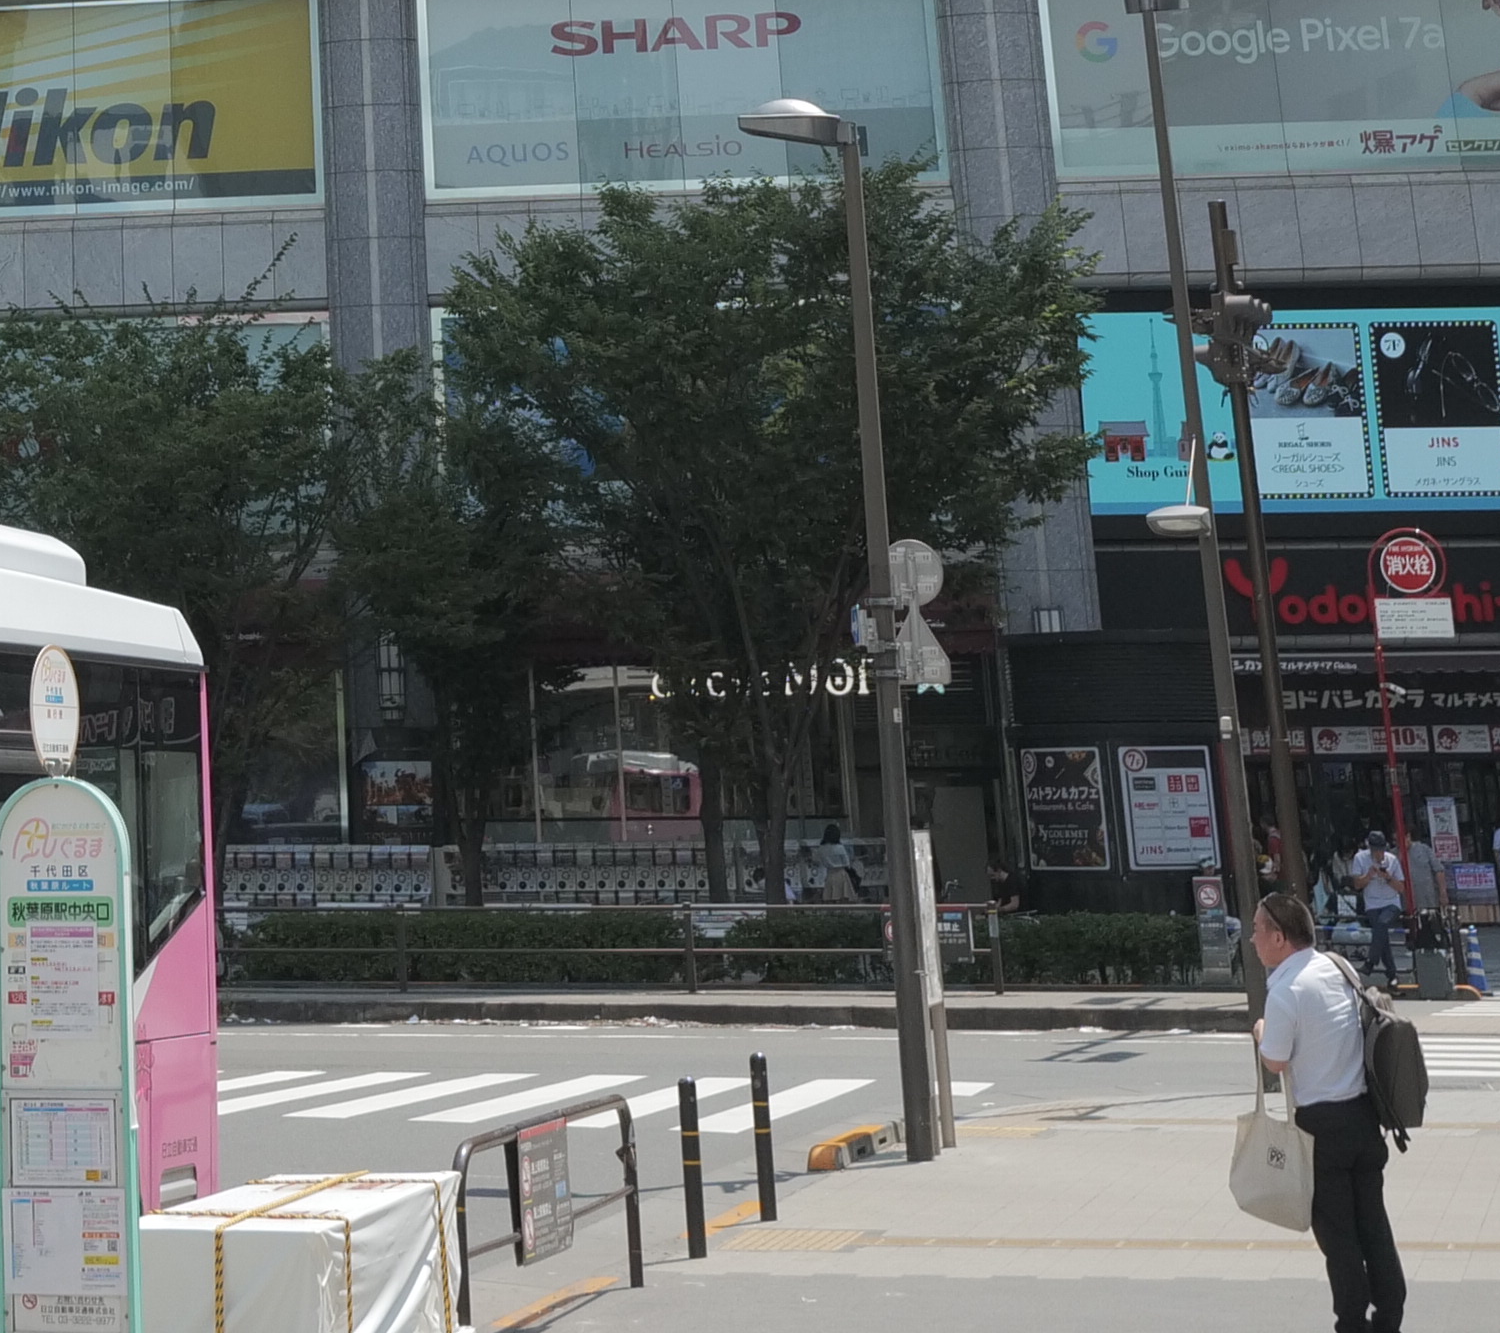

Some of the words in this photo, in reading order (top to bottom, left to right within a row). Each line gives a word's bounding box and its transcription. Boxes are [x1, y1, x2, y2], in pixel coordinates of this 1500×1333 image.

[549, 11, 803, 57] SHARP
[1156, 23, 1291, 67] Google
[1300, 18, 1391, 51] Pixel
[1398, 15, 1447, 50] 7a
[465, 138, 573, 167] AQUOS
[1274, 452, 1341, 464] リーガルシューズ
[1126, 466, 1160, 481] Shop
[1386, 554, 1430, 575] 消火栓
[30, 865, 88, 877] 千代田区
[12, 902, 109, 921] 秋葉原駅中央口
